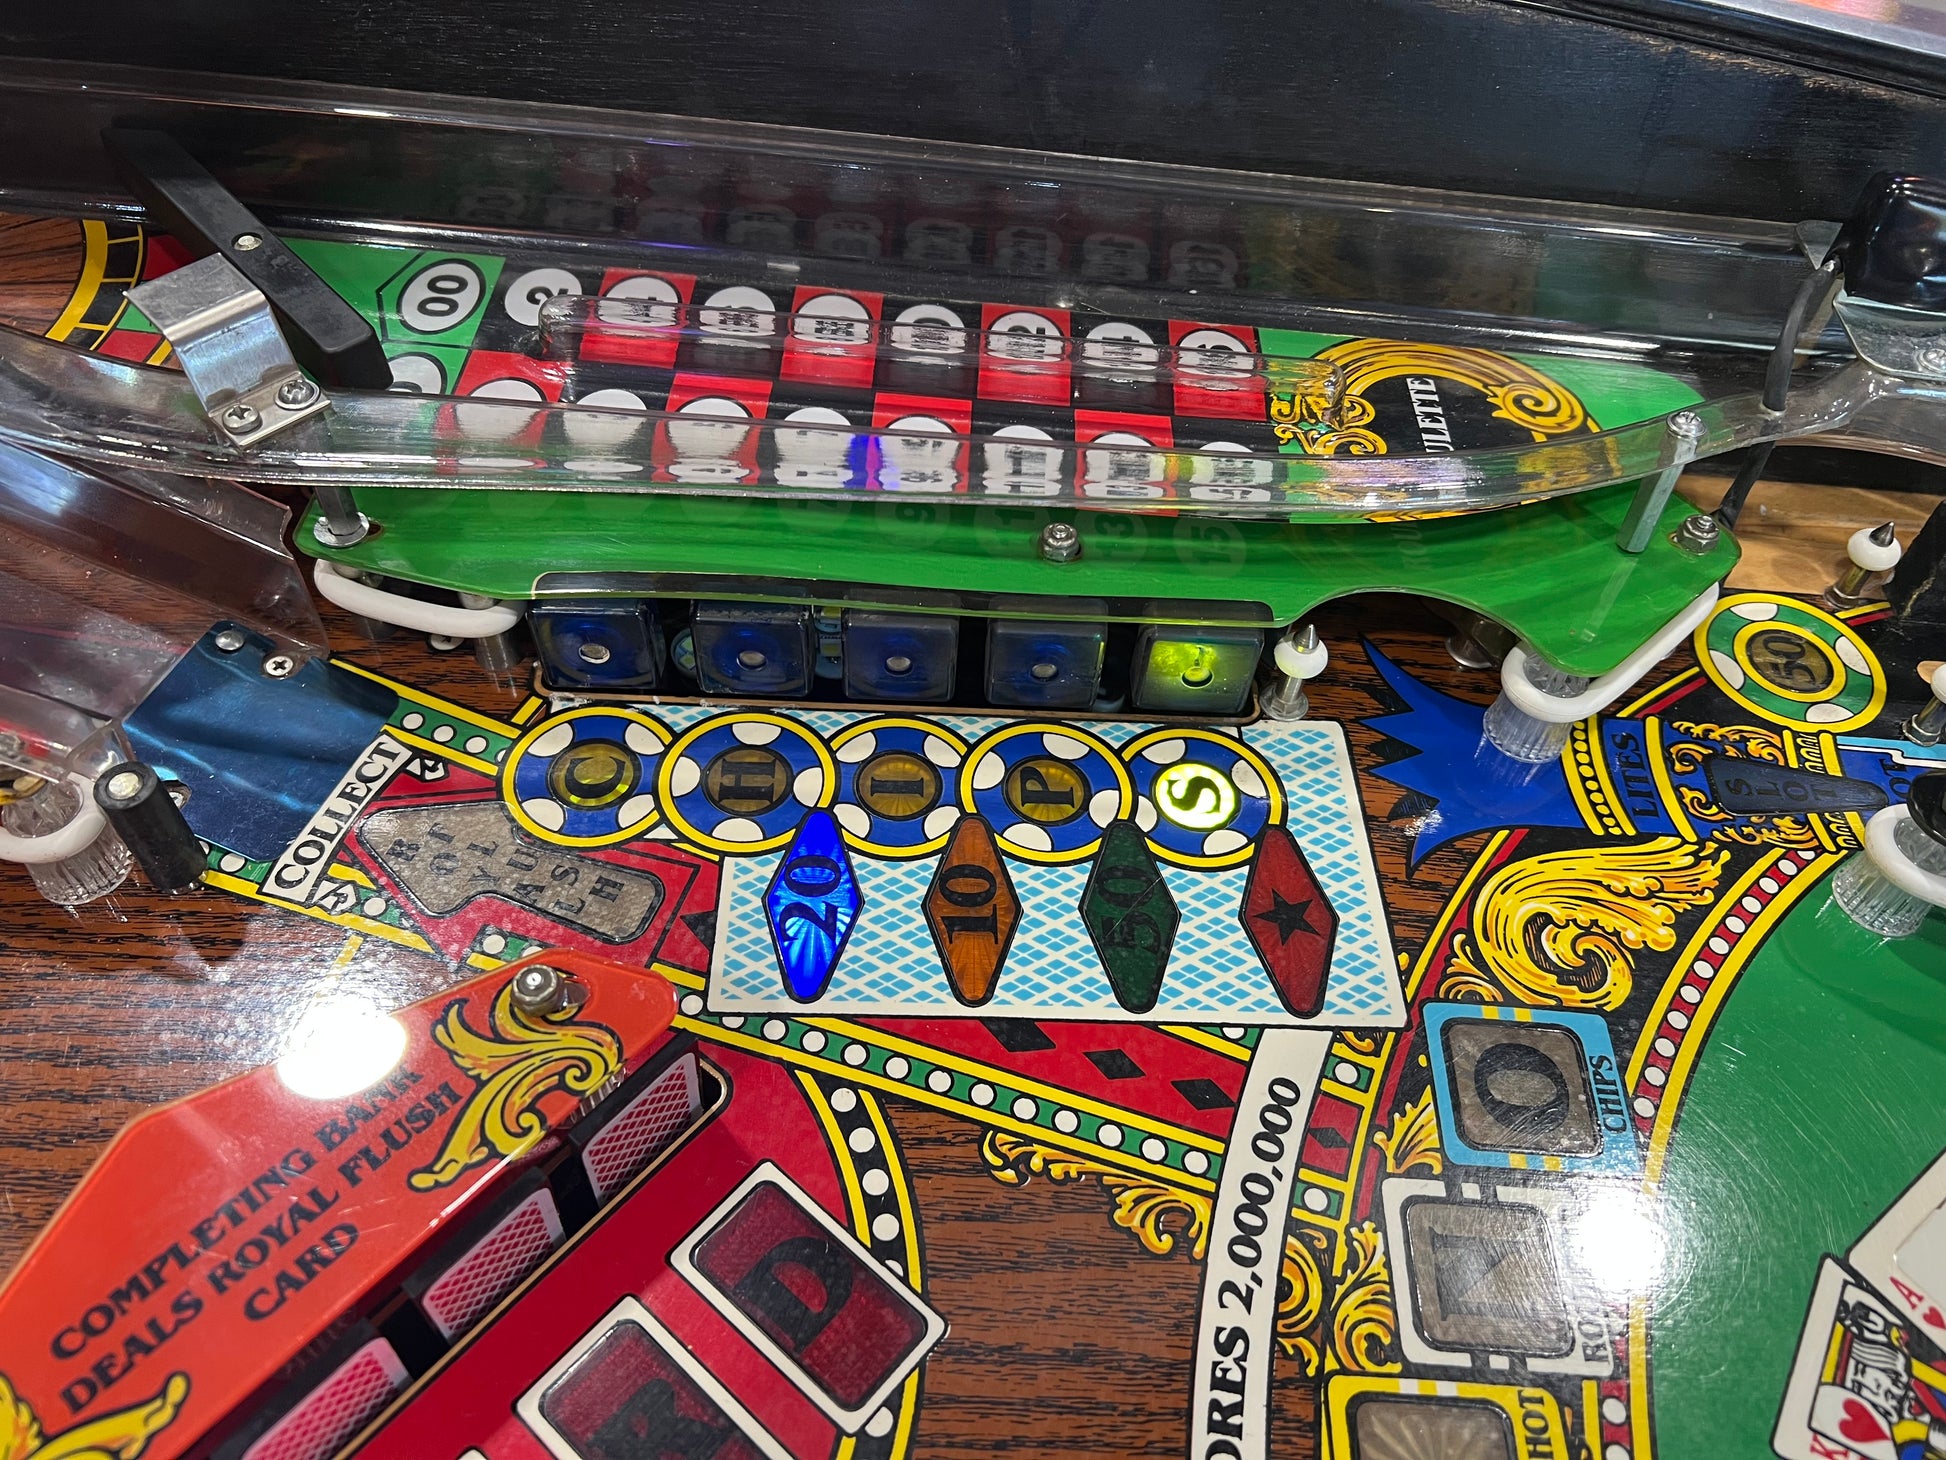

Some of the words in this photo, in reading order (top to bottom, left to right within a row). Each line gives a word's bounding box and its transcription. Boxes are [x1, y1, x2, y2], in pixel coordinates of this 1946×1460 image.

[416, 273, 470, 318] 00
[1406, 377, 1455, 453] ULETTE
[273, 741, 403, 890] COLLECT
[1611, 732, 1659, 819] LITES
[779, 855, 842, 944] 20
[939, 864, 999, 945] 10
[1100, 864, 1160, 949] 50
[1589, 1053, 1628, 1134] CHIPS
[49, 1148, 318, 1360] COMPLETING
[314, 1066, 424, 1152] BANK
[1217, 1076, 1302, 1315] 2,000,000
[59, 1290, 206, 1416] DEALS
[204, 1186, 341, 1296] ROYAL
[338, 1081, 463, 1188] FLUSH
[242, 1222, 361, 1321] CARD
[734, 1236, 852, 1352] D
[1889, 1276, 1924, 1310] A
